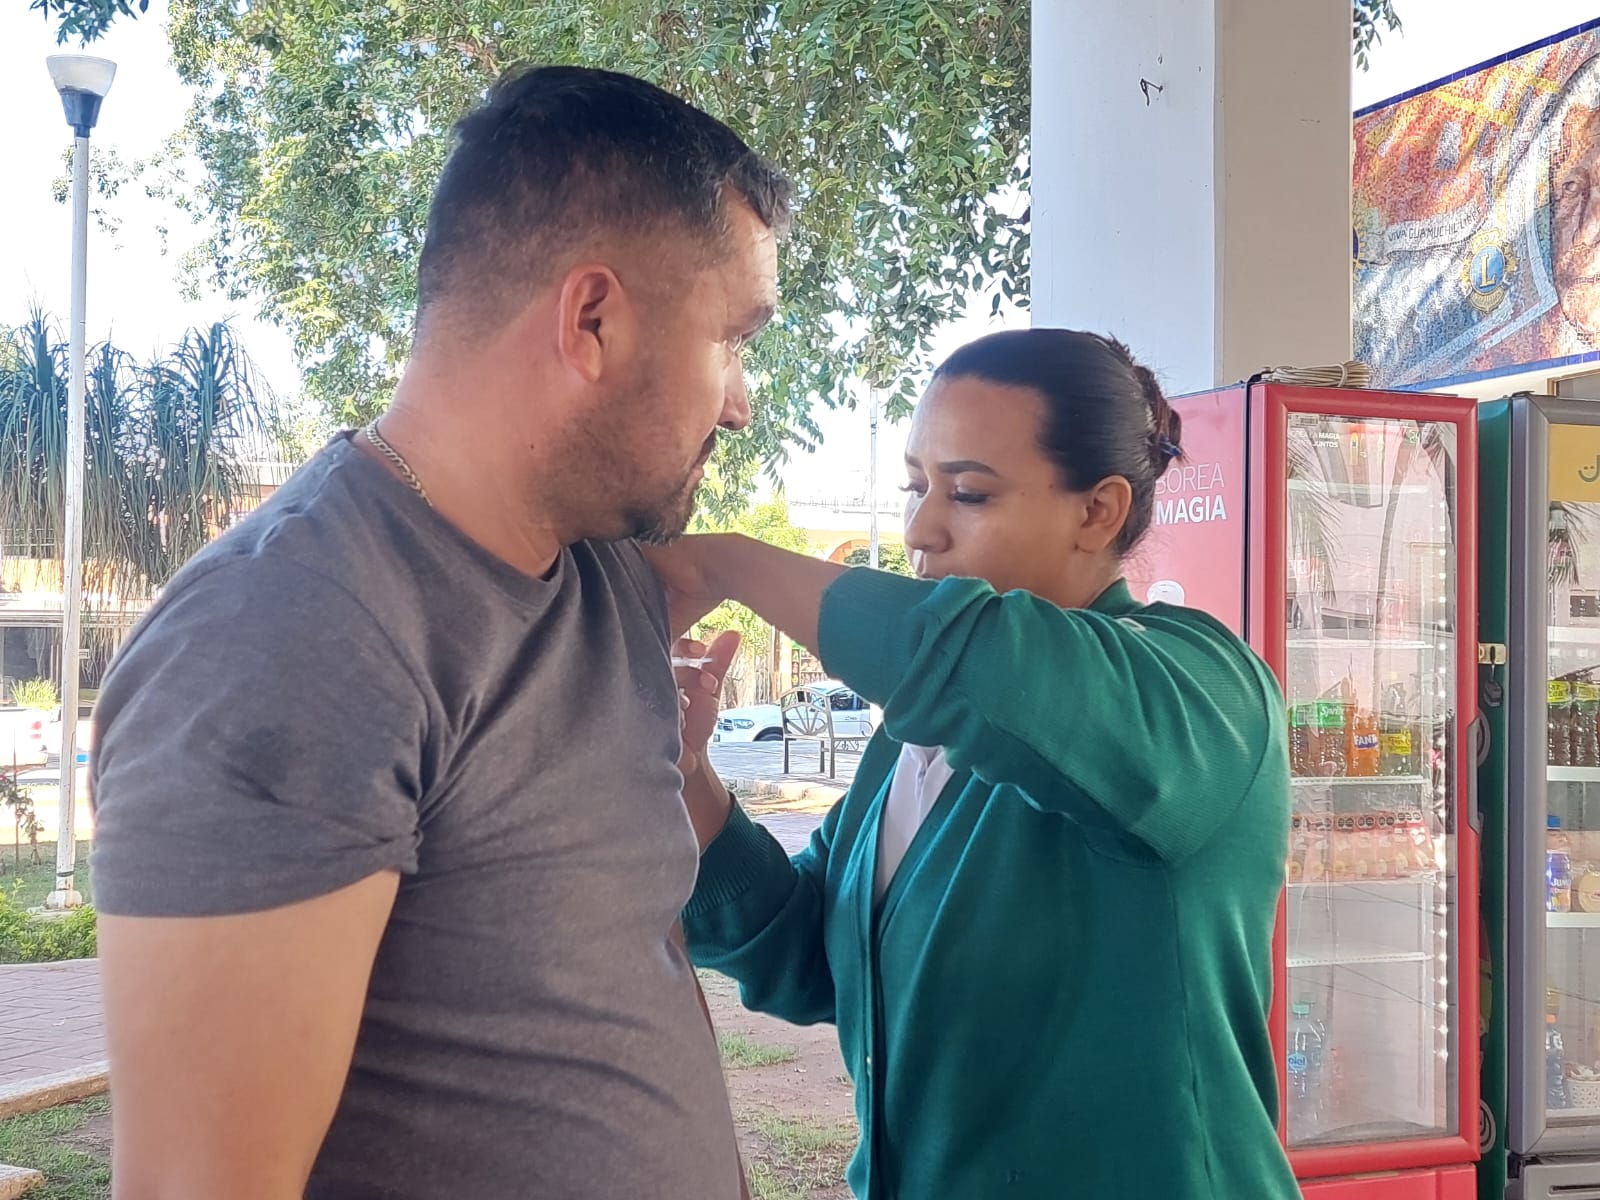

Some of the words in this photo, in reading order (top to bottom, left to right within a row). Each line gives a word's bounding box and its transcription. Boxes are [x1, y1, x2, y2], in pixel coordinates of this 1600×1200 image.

[1387, 229, 1408, 242] VIVA
[1155, 495, 1227, 525] MAGIA
[1354, 734, 1378, 745] FANT
